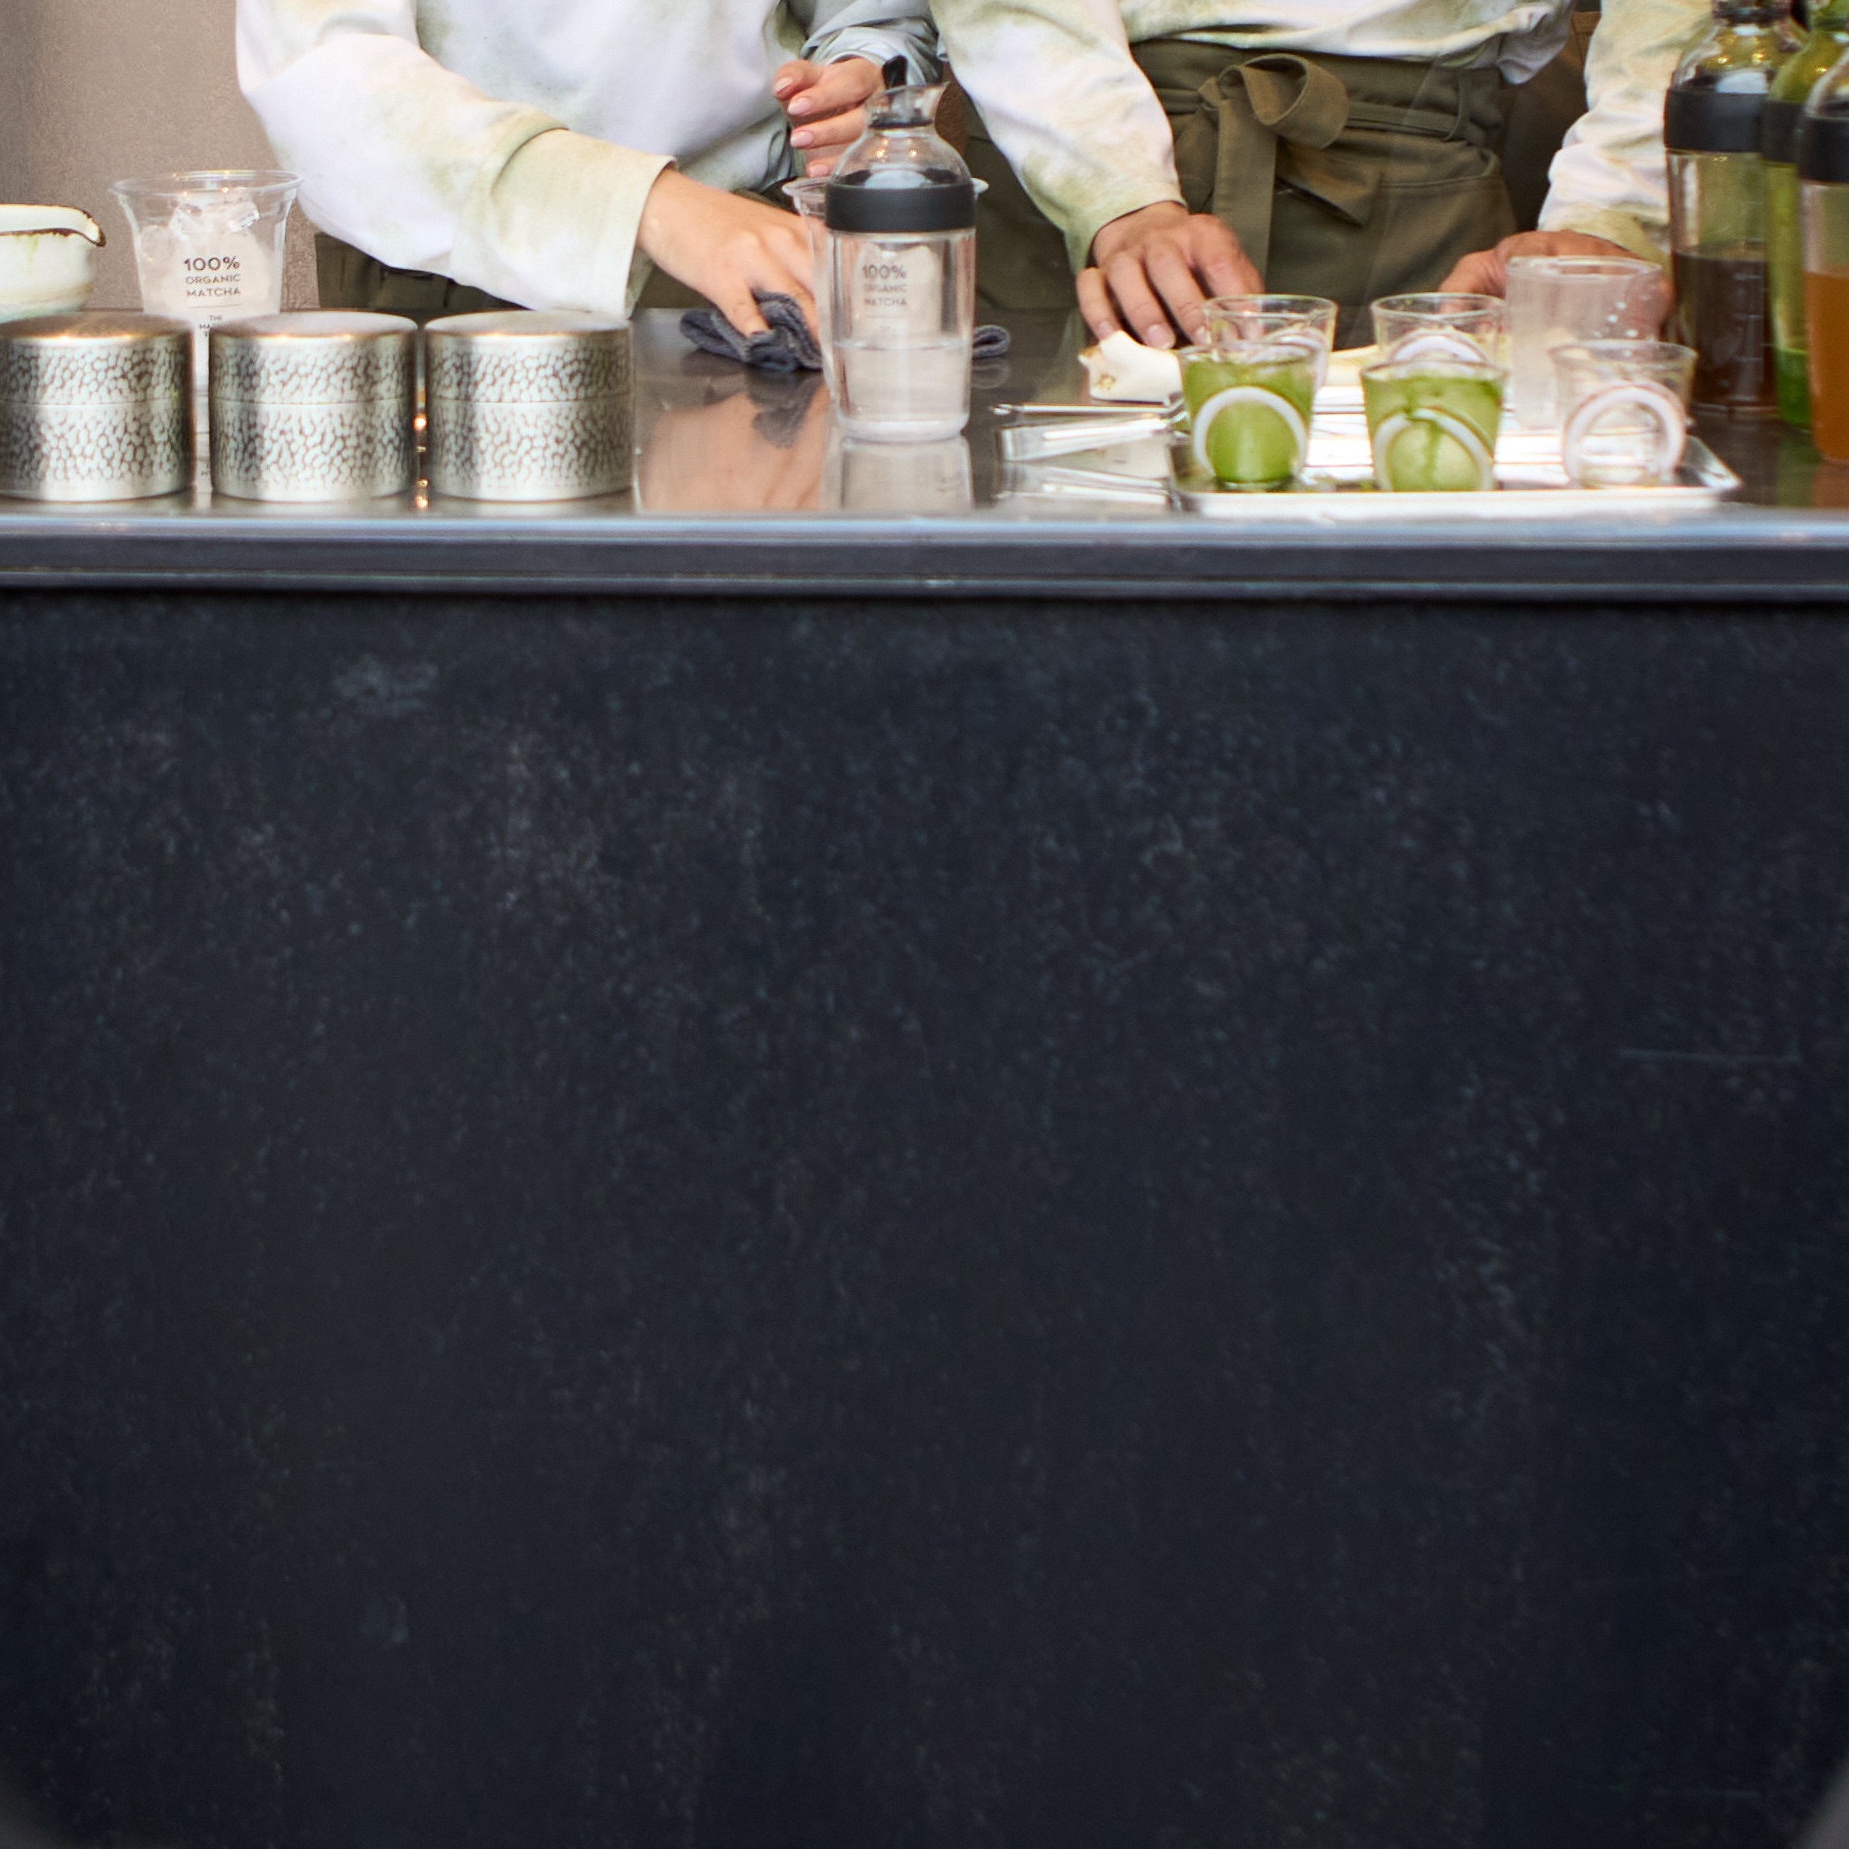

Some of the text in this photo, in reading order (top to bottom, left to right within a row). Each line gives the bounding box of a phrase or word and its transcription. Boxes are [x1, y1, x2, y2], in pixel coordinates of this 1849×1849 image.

[184, 256, 240, 271] 100%
[862, 264, 907, 279] 100%
[185, 273, 241, 285] ORGANIC
[186, 287, 241, 297] MATCHA
